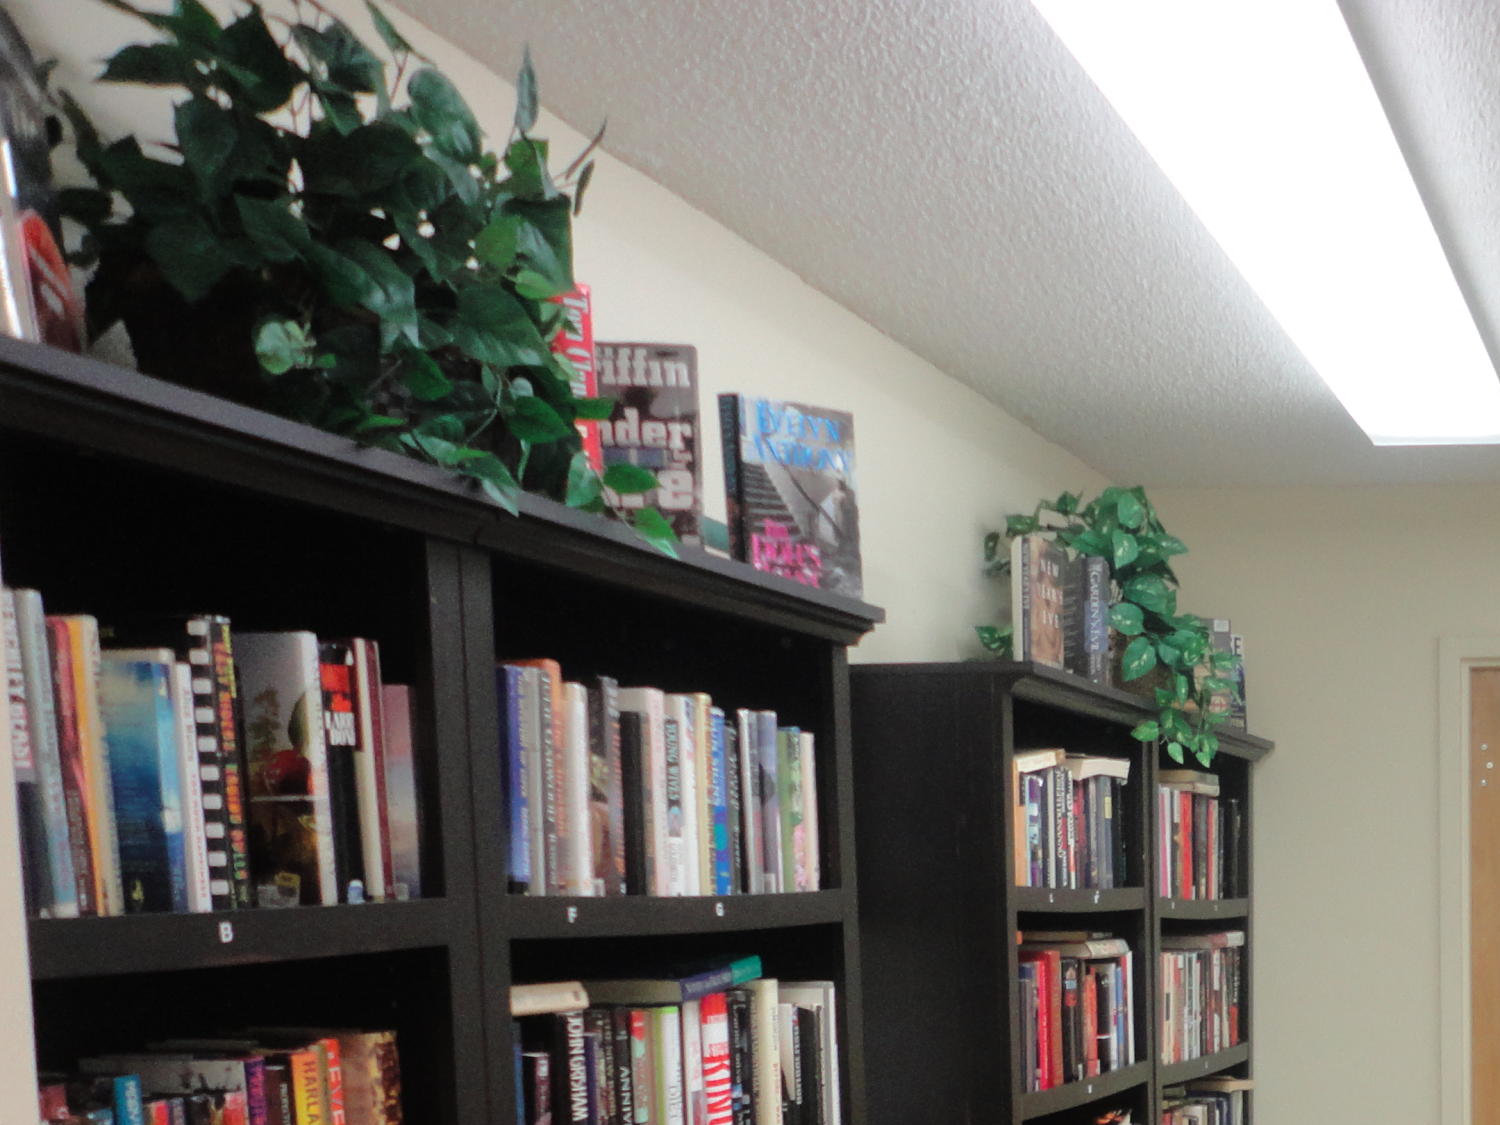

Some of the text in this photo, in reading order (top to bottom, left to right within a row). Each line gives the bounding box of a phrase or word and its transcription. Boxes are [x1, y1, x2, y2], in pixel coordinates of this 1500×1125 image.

[219, 920, 233, 943] B
[566, 1016, 585, 1055] JOHN
[569, 1057, 588, 1121] GRISHAM
